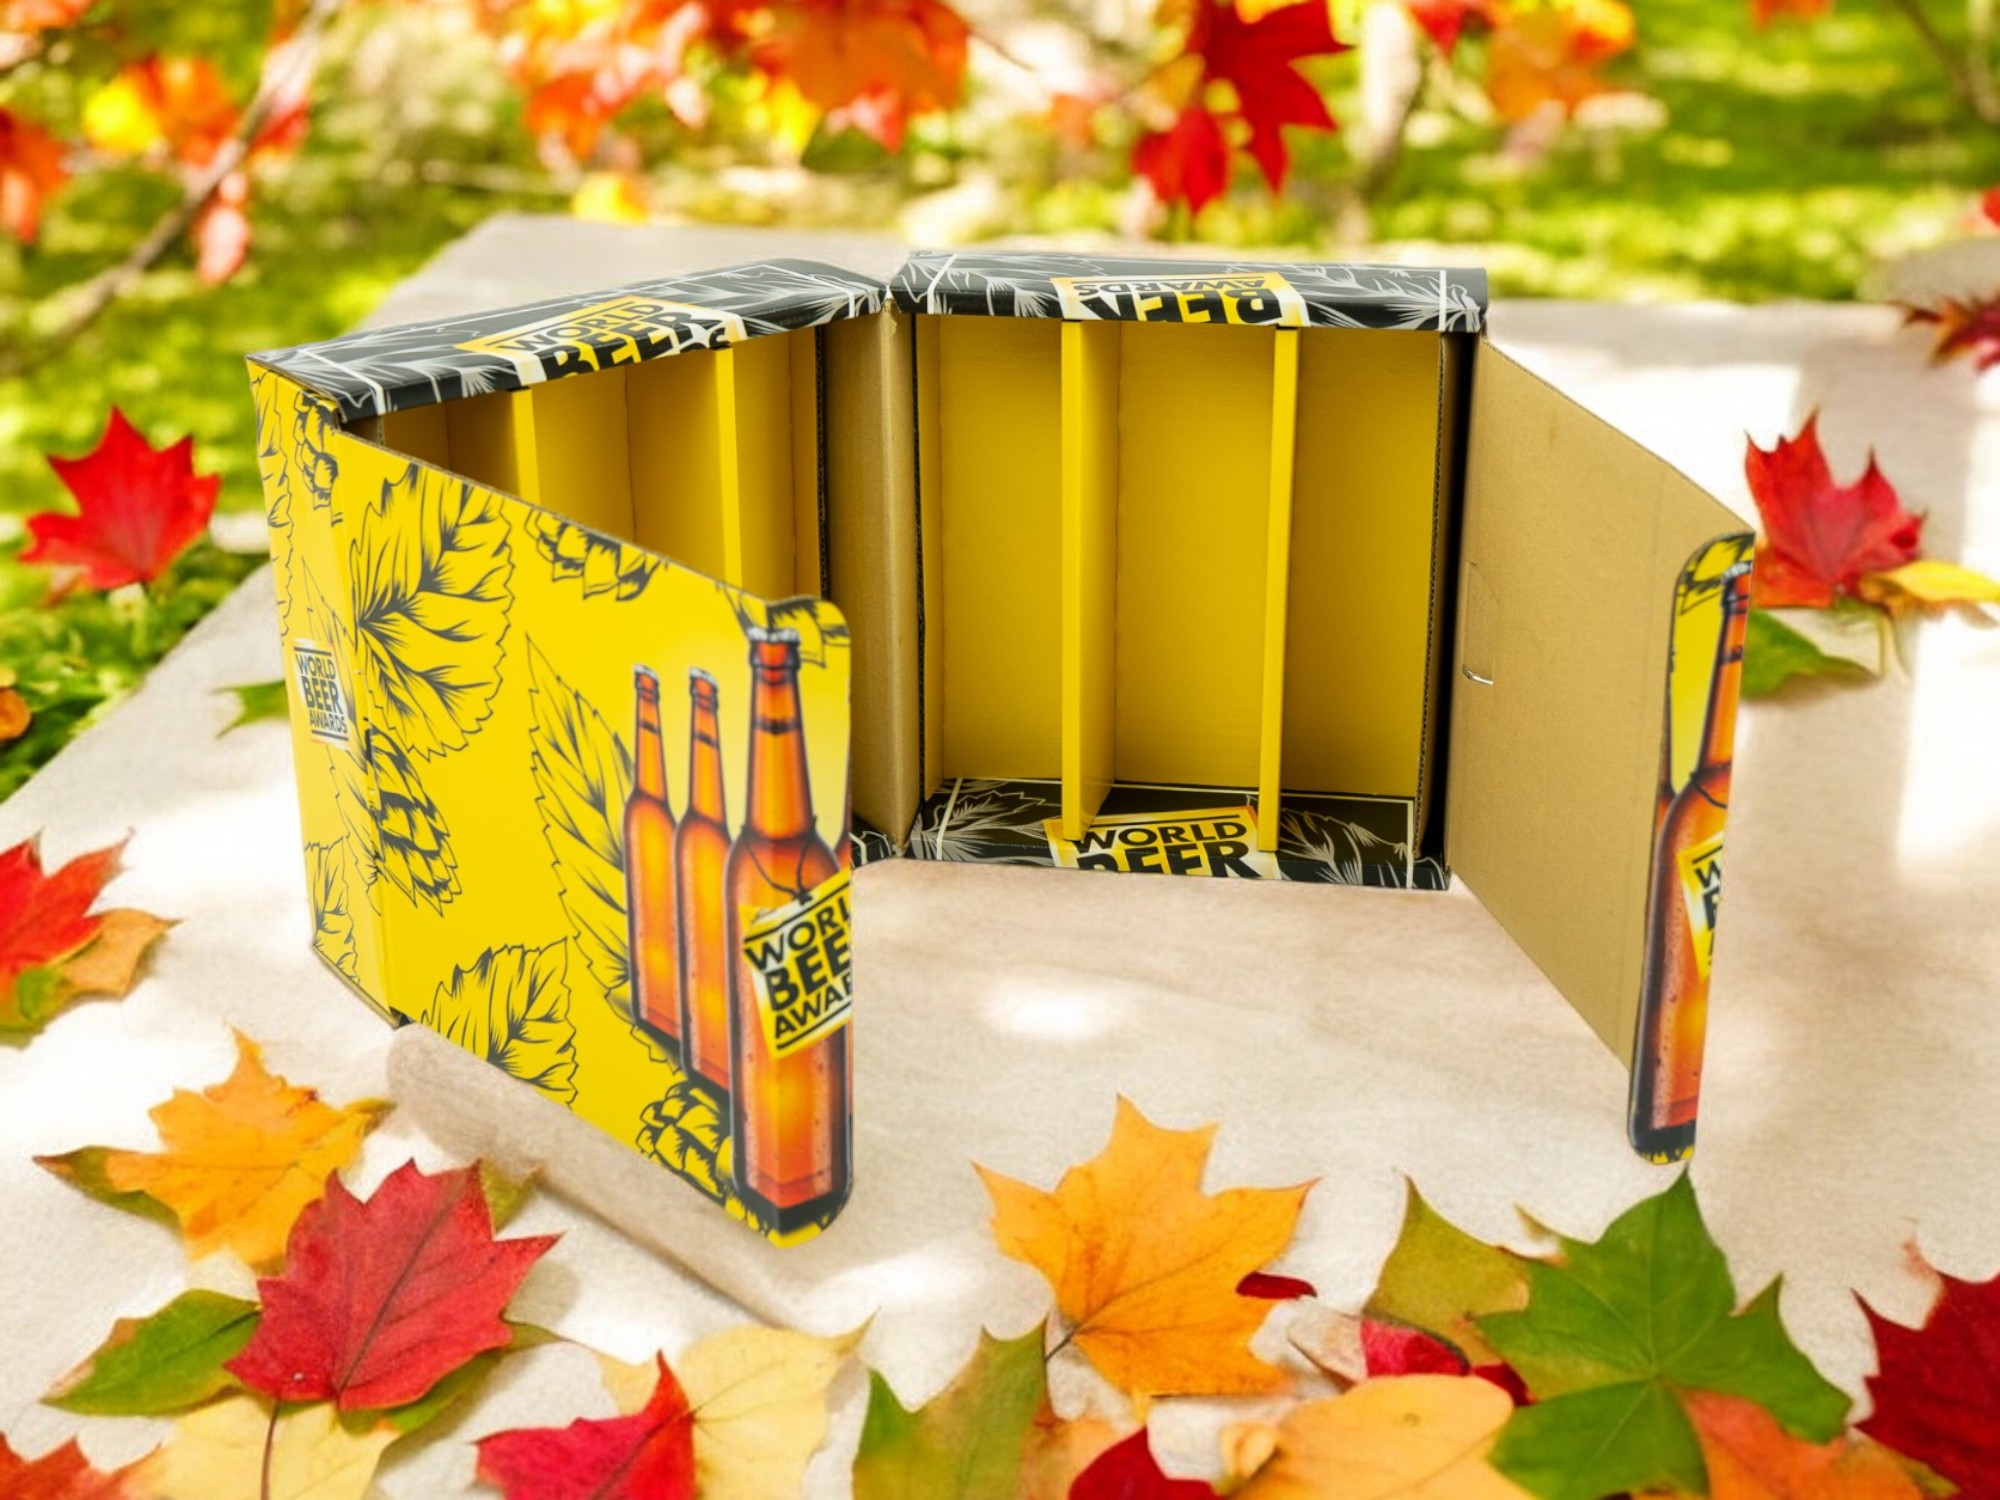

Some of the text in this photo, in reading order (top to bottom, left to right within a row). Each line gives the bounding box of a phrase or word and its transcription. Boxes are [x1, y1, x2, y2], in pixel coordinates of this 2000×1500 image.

[1072, 280, 1266, 296] AWARDS
[499, 304, 664, 352] WORLD
[295, 653, 336, 680] WORLD
[301, 675, 343, 715] BEER
[309, 709, 348, 734] AWARDS
[1076, 822, 1248, 854] WORLD
